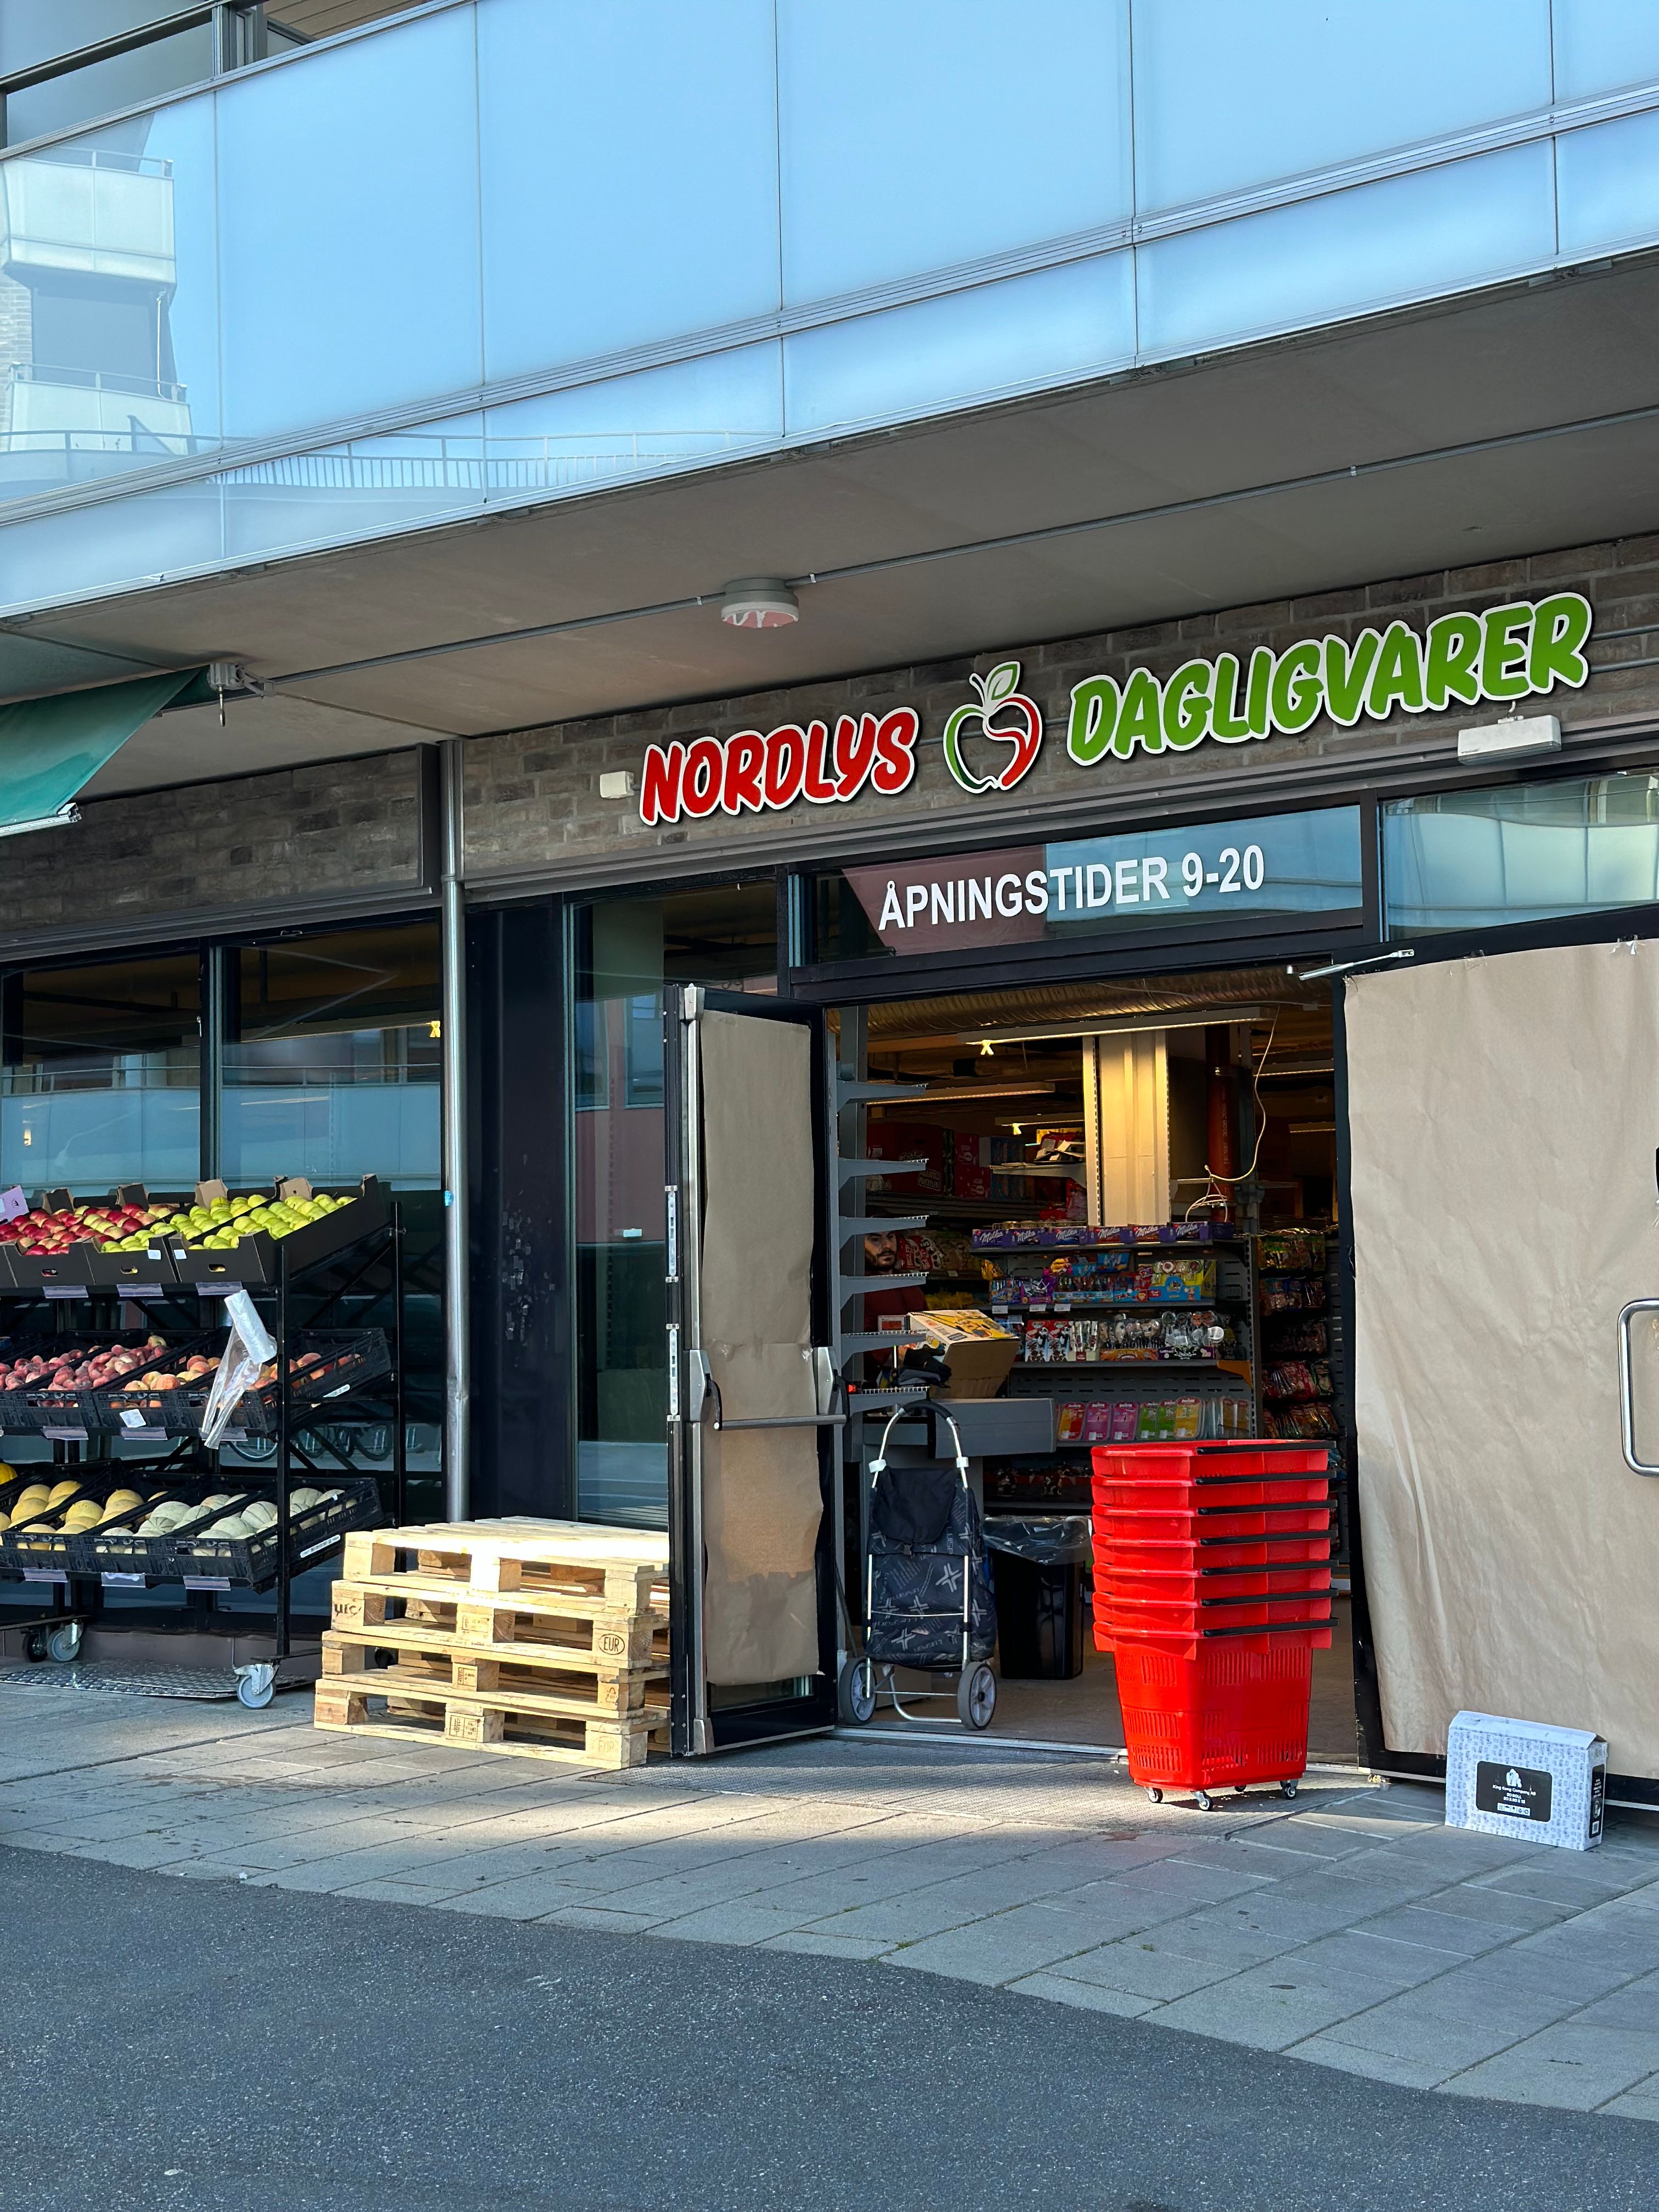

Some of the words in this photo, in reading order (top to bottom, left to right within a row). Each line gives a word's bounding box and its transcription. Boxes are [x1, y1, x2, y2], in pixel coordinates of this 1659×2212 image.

[639, 708, 919, 824] NORDLYS
[1068, 593, 1591, 764] DAGLIGVARER
[878, 857, 1171, 931] ÅPNINGSTIDER
[1182, 845, 1265, 897] 9-20
[979, 1230, 1003, 1243] Milka
[1017, 1229, 1036, 1242] Milka
[1056, 1228, 1079, 1240] Milka
[1098, 1226, 1120, 1239] Milka
[1136, 1225, 1159, 1237] Milka
[1176, 1224, 1198, 1236] Milka
[603, 1636, 619, 1652] EUR
